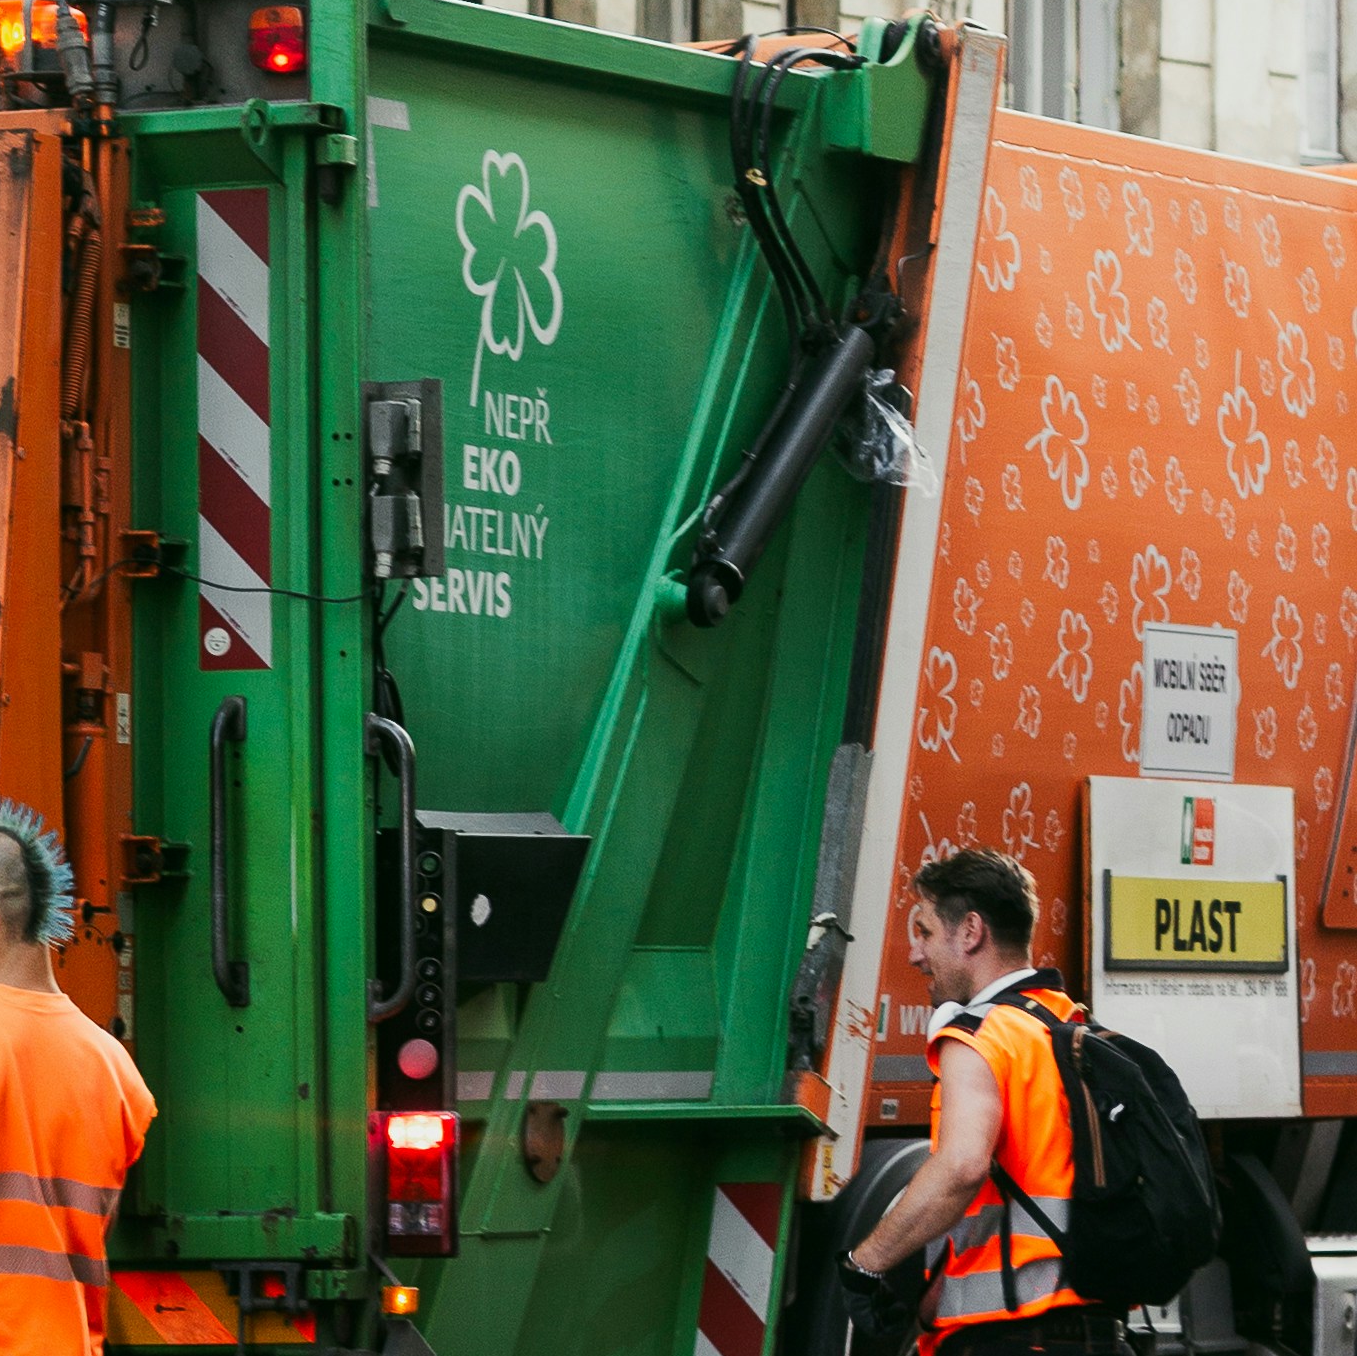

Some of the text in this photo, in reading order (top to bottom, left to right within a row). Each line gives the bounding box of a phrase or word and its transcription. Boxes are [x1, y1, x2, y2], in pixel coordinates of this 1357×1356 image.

[484, 386, 553, 445] NEPŘ
[462, 443, 521, 496] EKO
[443, 502, 549, 560] ATELNÝ
[412, 567, 512, 619] SERVIS
[1155, 897, 1242, 953] PLAST
